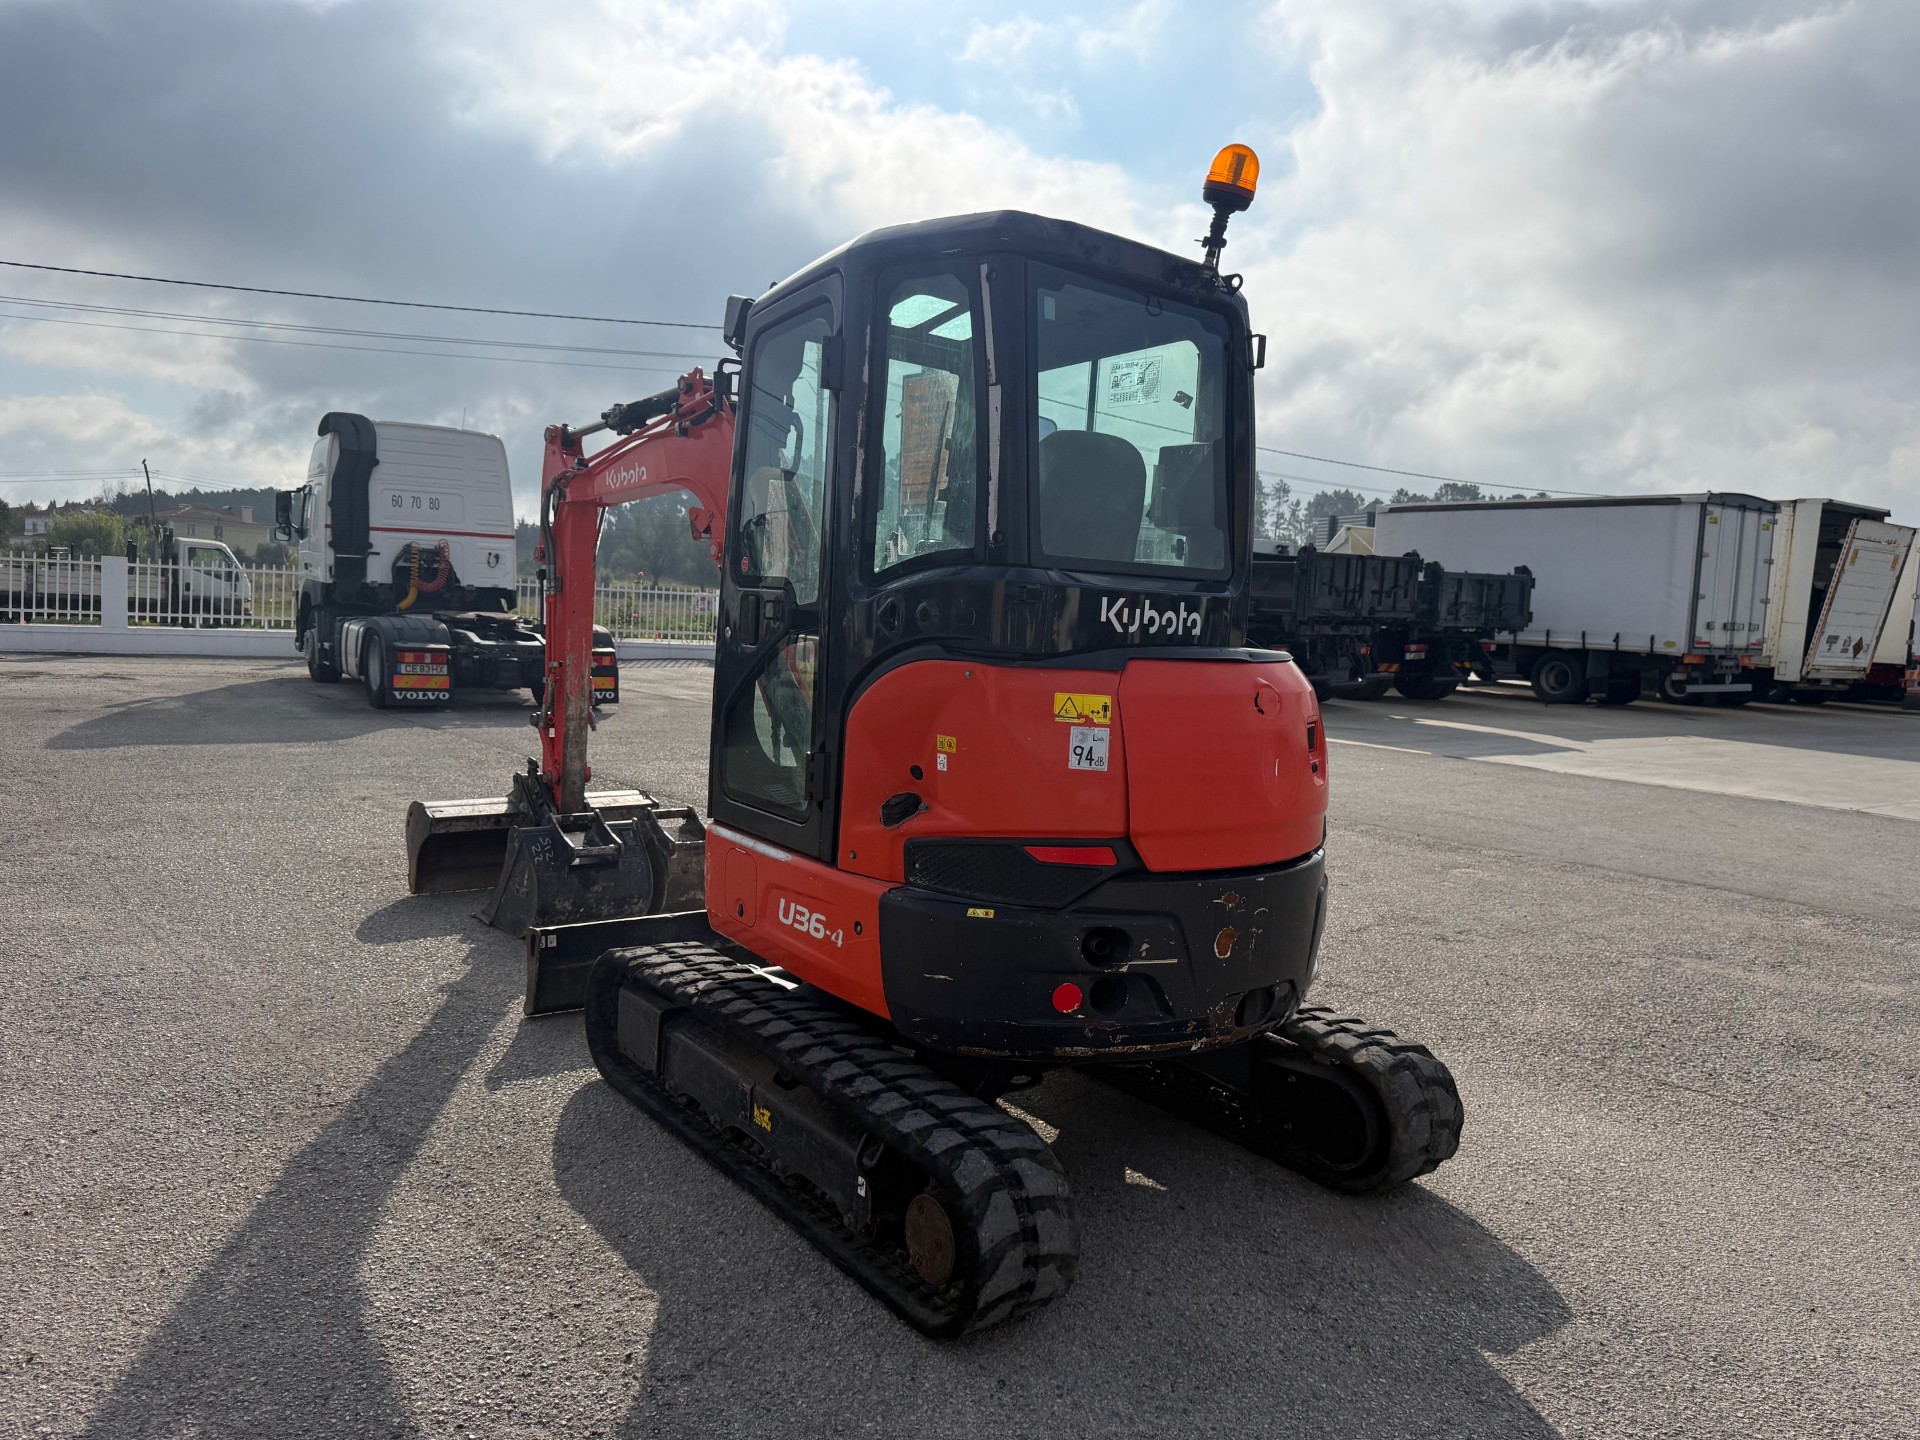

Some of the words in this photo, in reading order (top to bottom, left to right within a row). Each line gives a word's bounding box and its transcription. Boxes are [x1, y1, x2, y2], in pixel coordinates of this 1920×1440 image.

[606, 462, 647, 488] Kubota
[392, 495, 402, 508] 60
[411, 496, 421, 509] 70
[429, 498, 439, 510] 80
[1101, 597, 1202, 636] Kubota
[392, 691, 450, 700] VOLVO
[779, 898, 844, 948] U36-4
